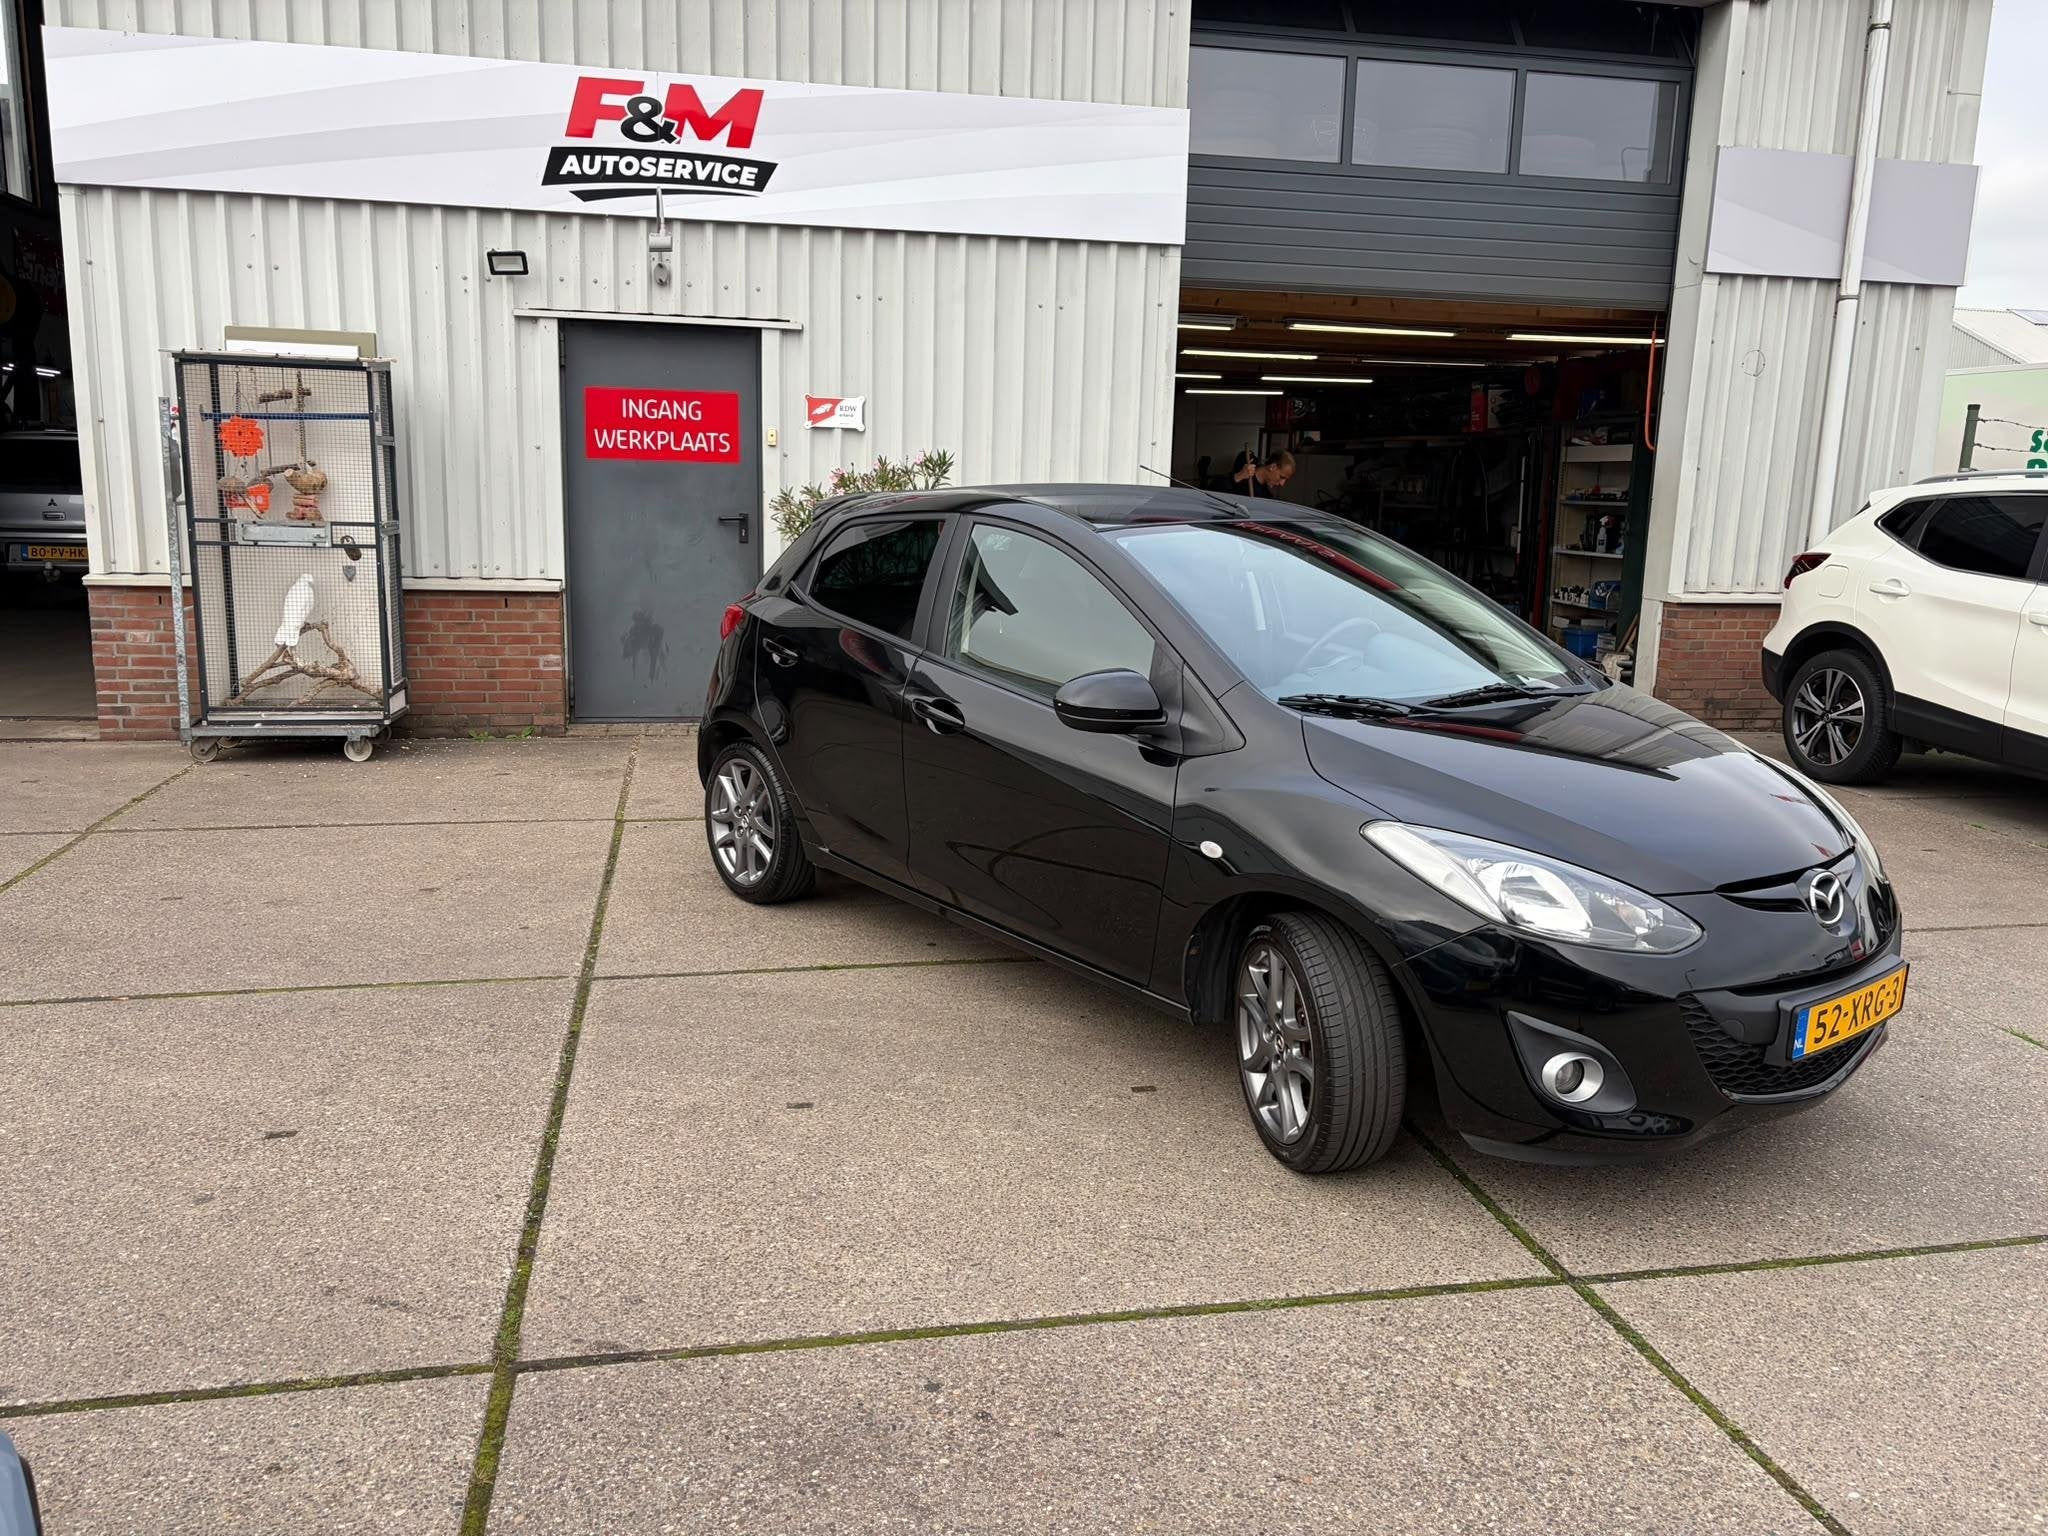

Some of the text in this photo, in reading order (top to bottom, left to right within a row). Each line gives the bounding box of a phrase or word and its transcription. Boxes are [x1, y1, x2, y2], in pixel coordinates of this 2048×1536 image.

[565, 77, 765, 149] F&M
[559, 154, 759, 187] AUTOSERVICE
[621, 398, 702, 421] INGANG
[593, 429, 731, 453] WERKPLAATS
[1813, 976, 1900, 1044] 52-XRG-3
[1794, 1038, 1804, 1050] NL
